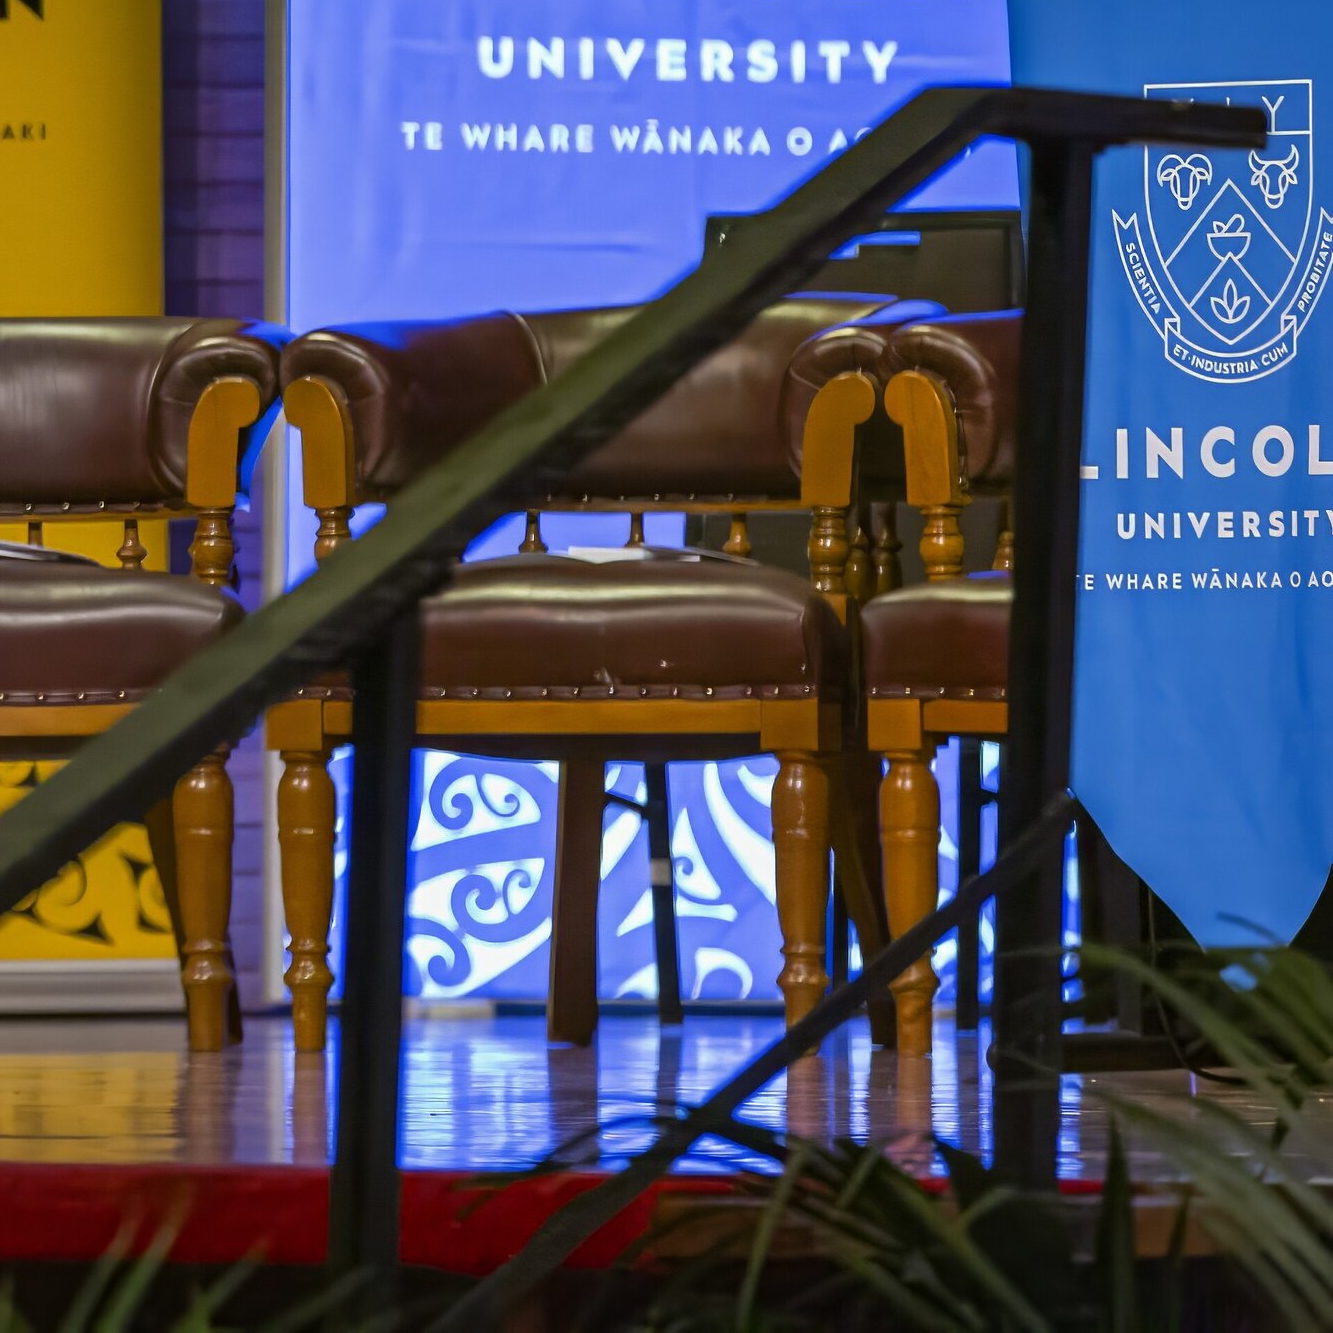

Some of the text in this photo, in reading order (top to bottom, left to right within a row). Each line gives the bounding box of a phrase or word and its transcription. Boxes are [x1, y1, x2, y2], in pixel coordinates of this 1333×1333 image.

[477, 35, 898, 84] UNIVERSITY
[402, 122, 443, 151] TE
[461, 122, 594, 154] WHARE
[610, 118, 771, 156] WĀNAKA
[787, 126, 813, 156] O
[1125, 242, 1161, 315] SCIENTIA
[1297, 231, 1333, 313] PROBITATE
[1261, 342, 1289, 366] CUM
[1106, 572, 1182, 590] WHARE
[1191, 568, 1283, 589] WĀNAKA
[1290, 570, 1301, 588] O
